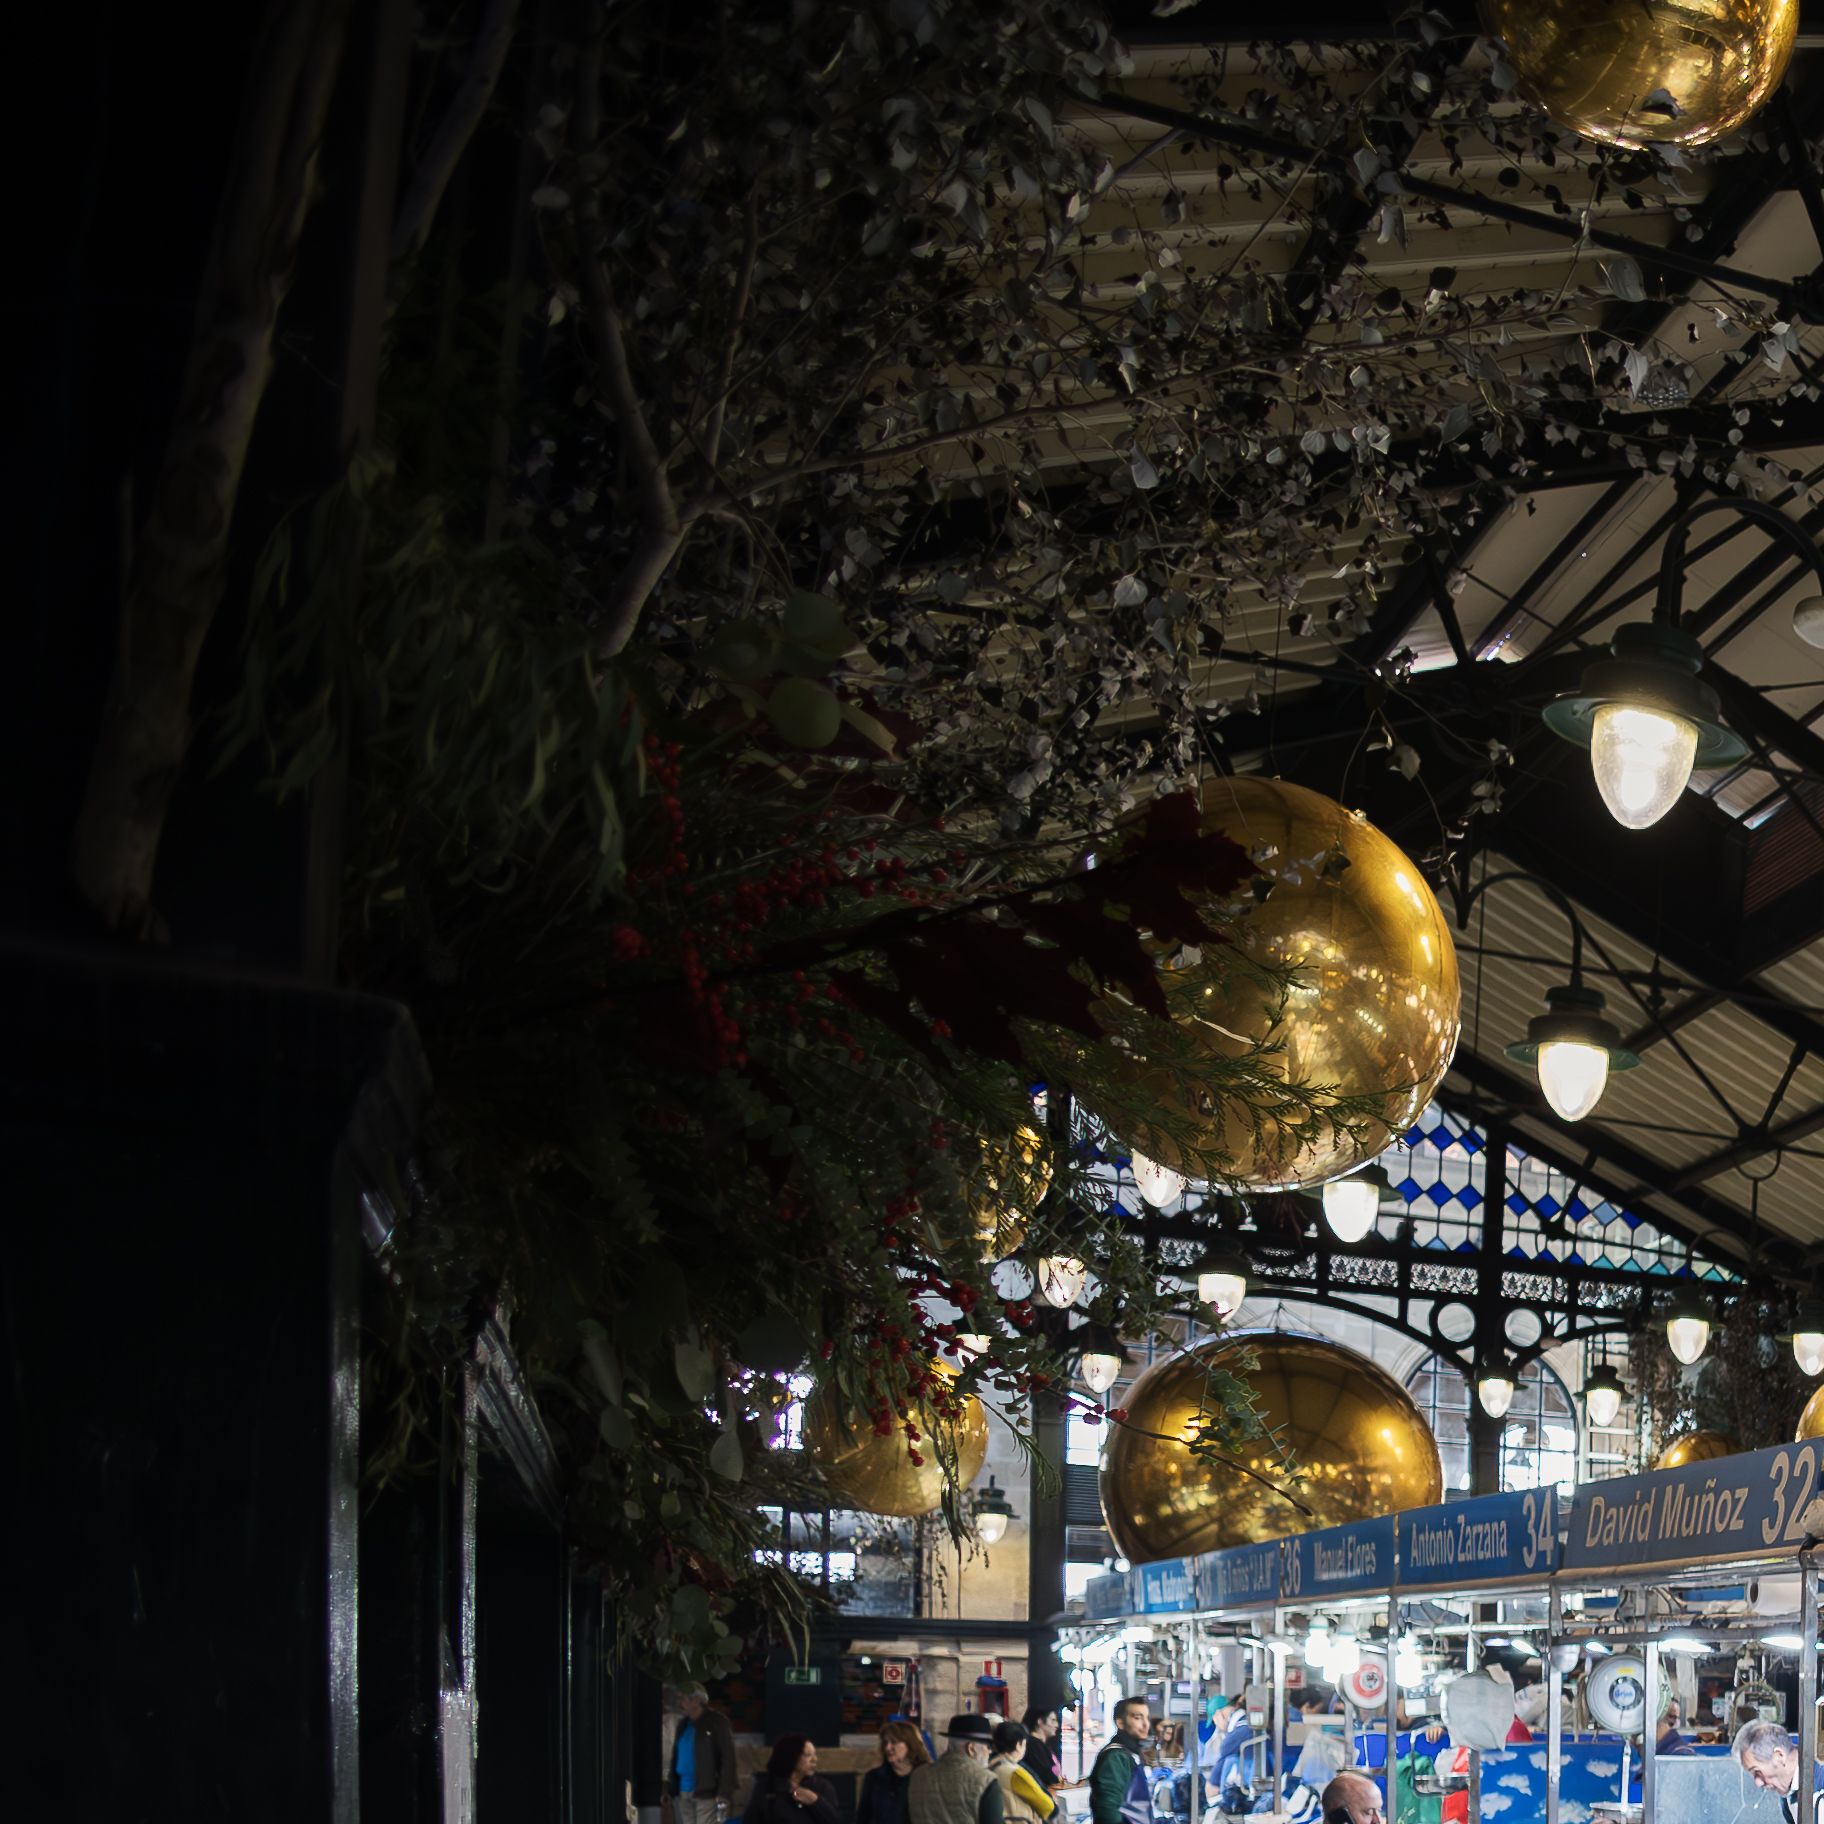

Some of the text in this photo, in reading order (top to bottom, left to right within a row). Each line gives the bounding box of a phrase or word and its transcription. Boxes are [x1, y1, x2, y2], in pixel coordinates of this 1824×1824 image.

[1410, 1489, 1555, 1569] Antonio Zarzana 34
[1585, 1445, 1816, 1549] David Muñoz 32
[1284, 1539, 1301, 1595] 36
